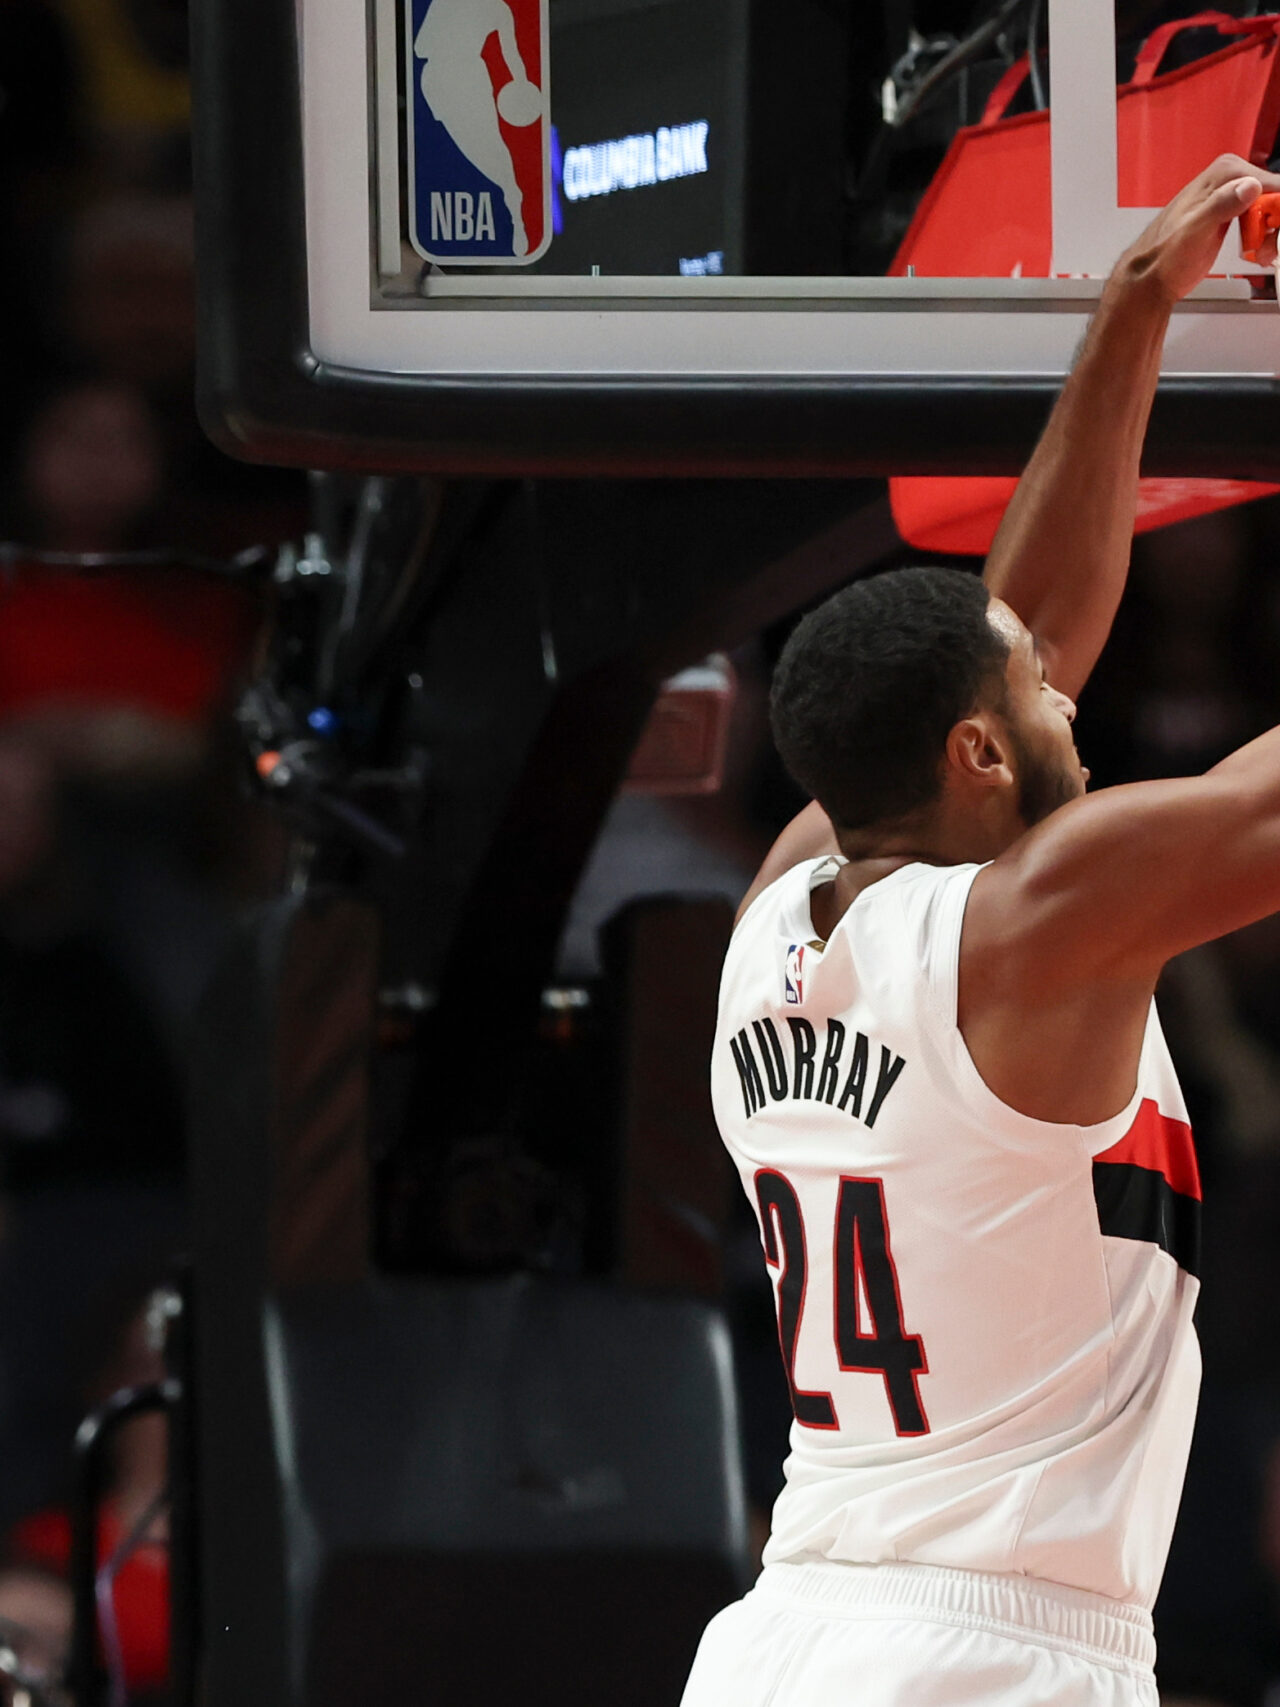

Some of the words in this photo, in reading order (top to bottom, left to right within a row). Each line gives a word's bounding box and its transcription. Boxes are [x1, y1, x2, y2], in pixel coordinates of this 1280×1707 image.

[430, 191, 496, 241] NBA
[729, 1017, 906, 1129] MURRAY
[754, 1167, 930, 1437] 24
